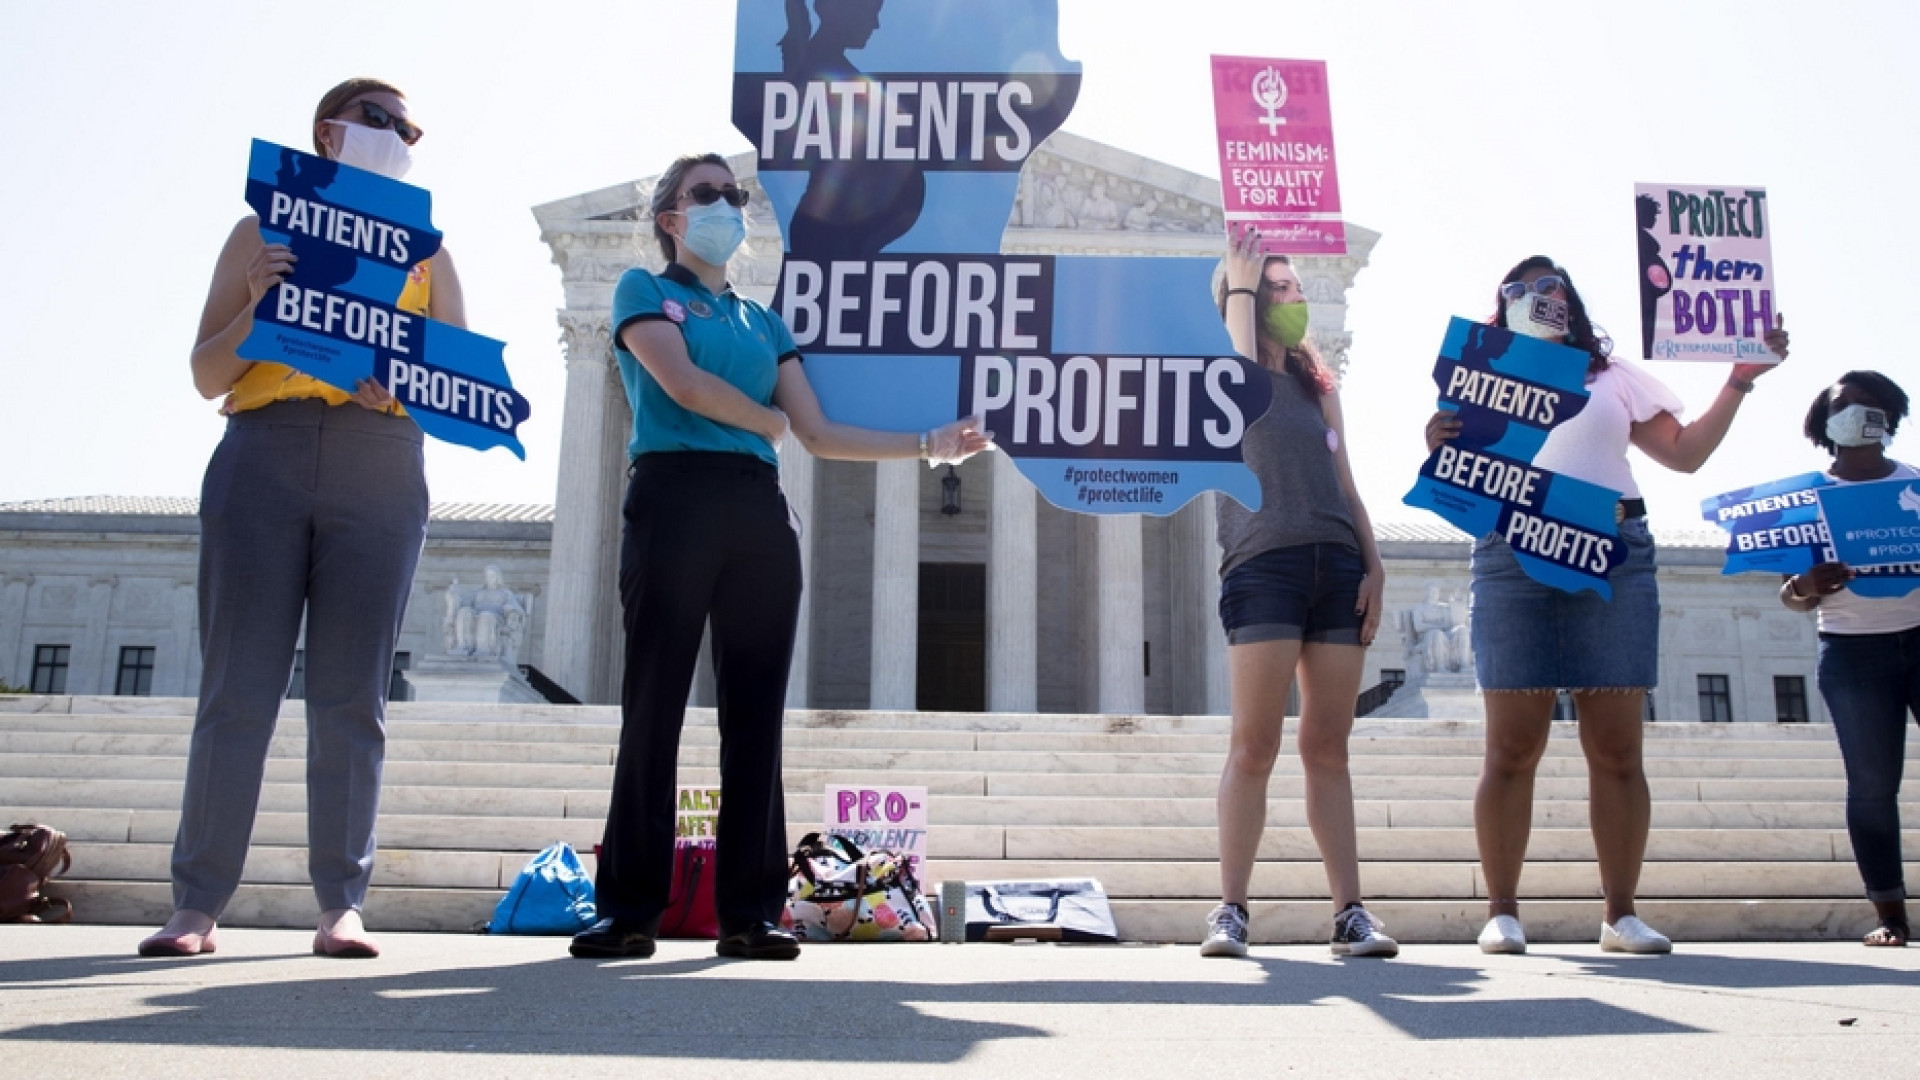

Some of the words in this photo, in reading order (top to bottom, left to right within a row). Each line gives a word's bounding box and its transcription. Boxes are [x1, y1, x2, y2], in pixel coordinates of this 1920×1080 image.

[762, 81, 1033, 161] PATIENTS
[1225, 140, 1329, 163] FEMINISM:
[1232, 168, 1324, 188] EQUALITY
[1240, 187, 1279, 207] FOR
[270, 191, 410, 263] PATIENTS
[1667, 189, 1766, 239] PROTECT
[1672, 244, 1763, 282] them
[277, 282, 411, 353] BEFORE
[782, 260, 1042, 349] BEFORE
[1672, 289, 1773, 338] BOTH
[388, 358, 513, 429] PROFITS
[971, 355, 1246, 449] PROFITS
[1447, 365, 1560, 425] PATIENTS
[1064, 466, 1179, 486] #protectwomen
[1078, 485, 1164, 506] #protectlife
[1434, 445, 1541, 507] BEFORE
[1718, 488, 1817, 521] PATIENTS
[1505, 510, 1613, 574] PROFITS
[837, 789, 921, 823] PRO-
